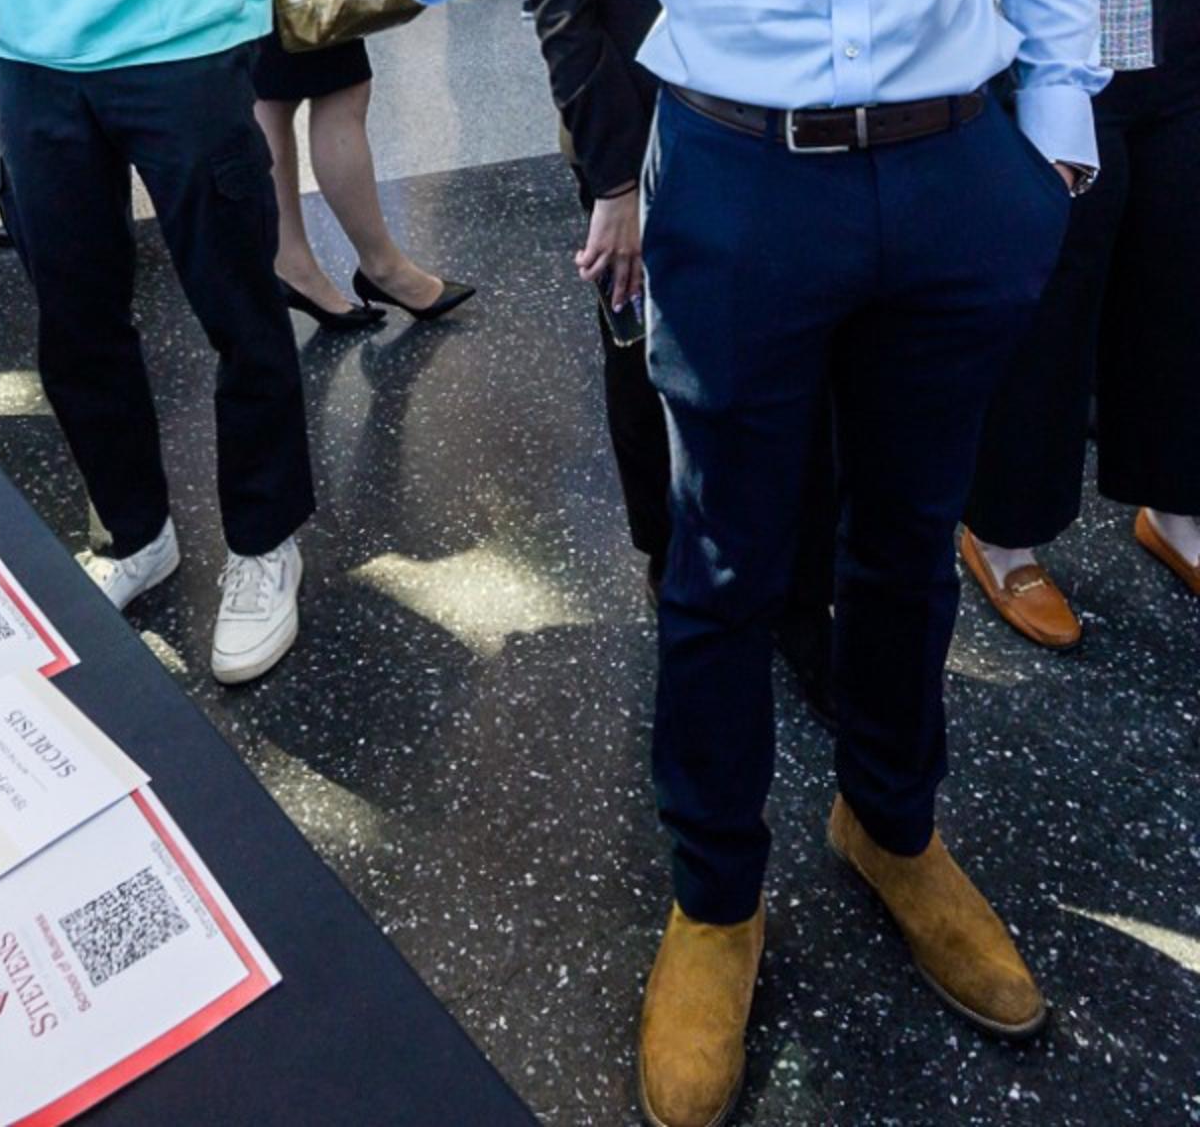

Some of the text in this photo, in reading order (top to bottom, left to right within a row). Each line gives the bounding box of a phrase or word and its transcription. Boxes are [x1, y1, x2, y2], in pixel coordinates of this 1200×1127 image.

[3, 708, 77, 778] SECRETS15
[33, 913, 92, 1013] School of Business
